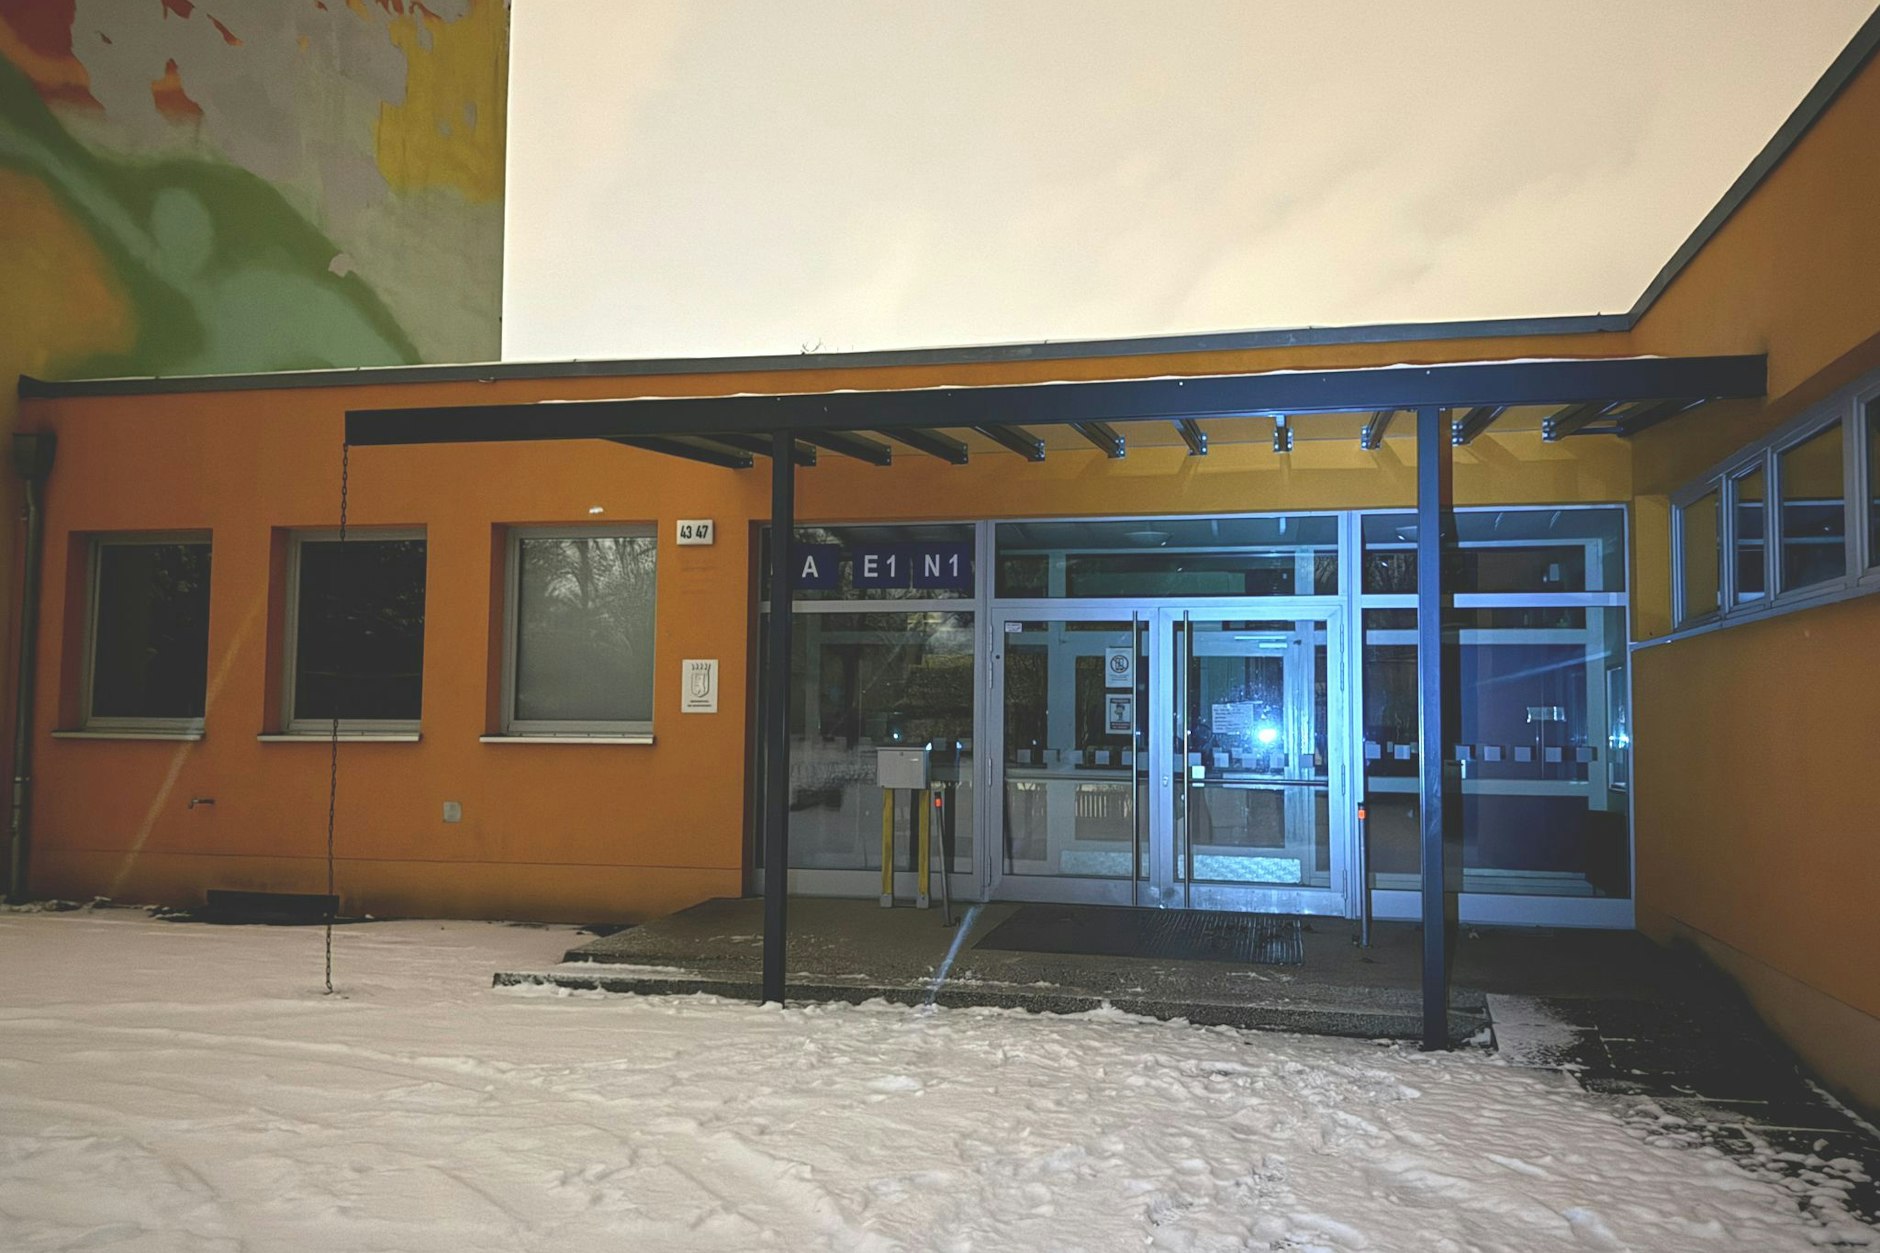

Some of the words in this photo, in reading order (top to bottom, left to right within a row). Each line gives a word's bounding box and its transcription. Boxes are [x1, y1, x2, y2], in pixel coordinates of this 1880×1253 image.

[680, 525, 692, 539] 43
[695, 525, 709, 539] 47
[801, 555, 819, 578] A
